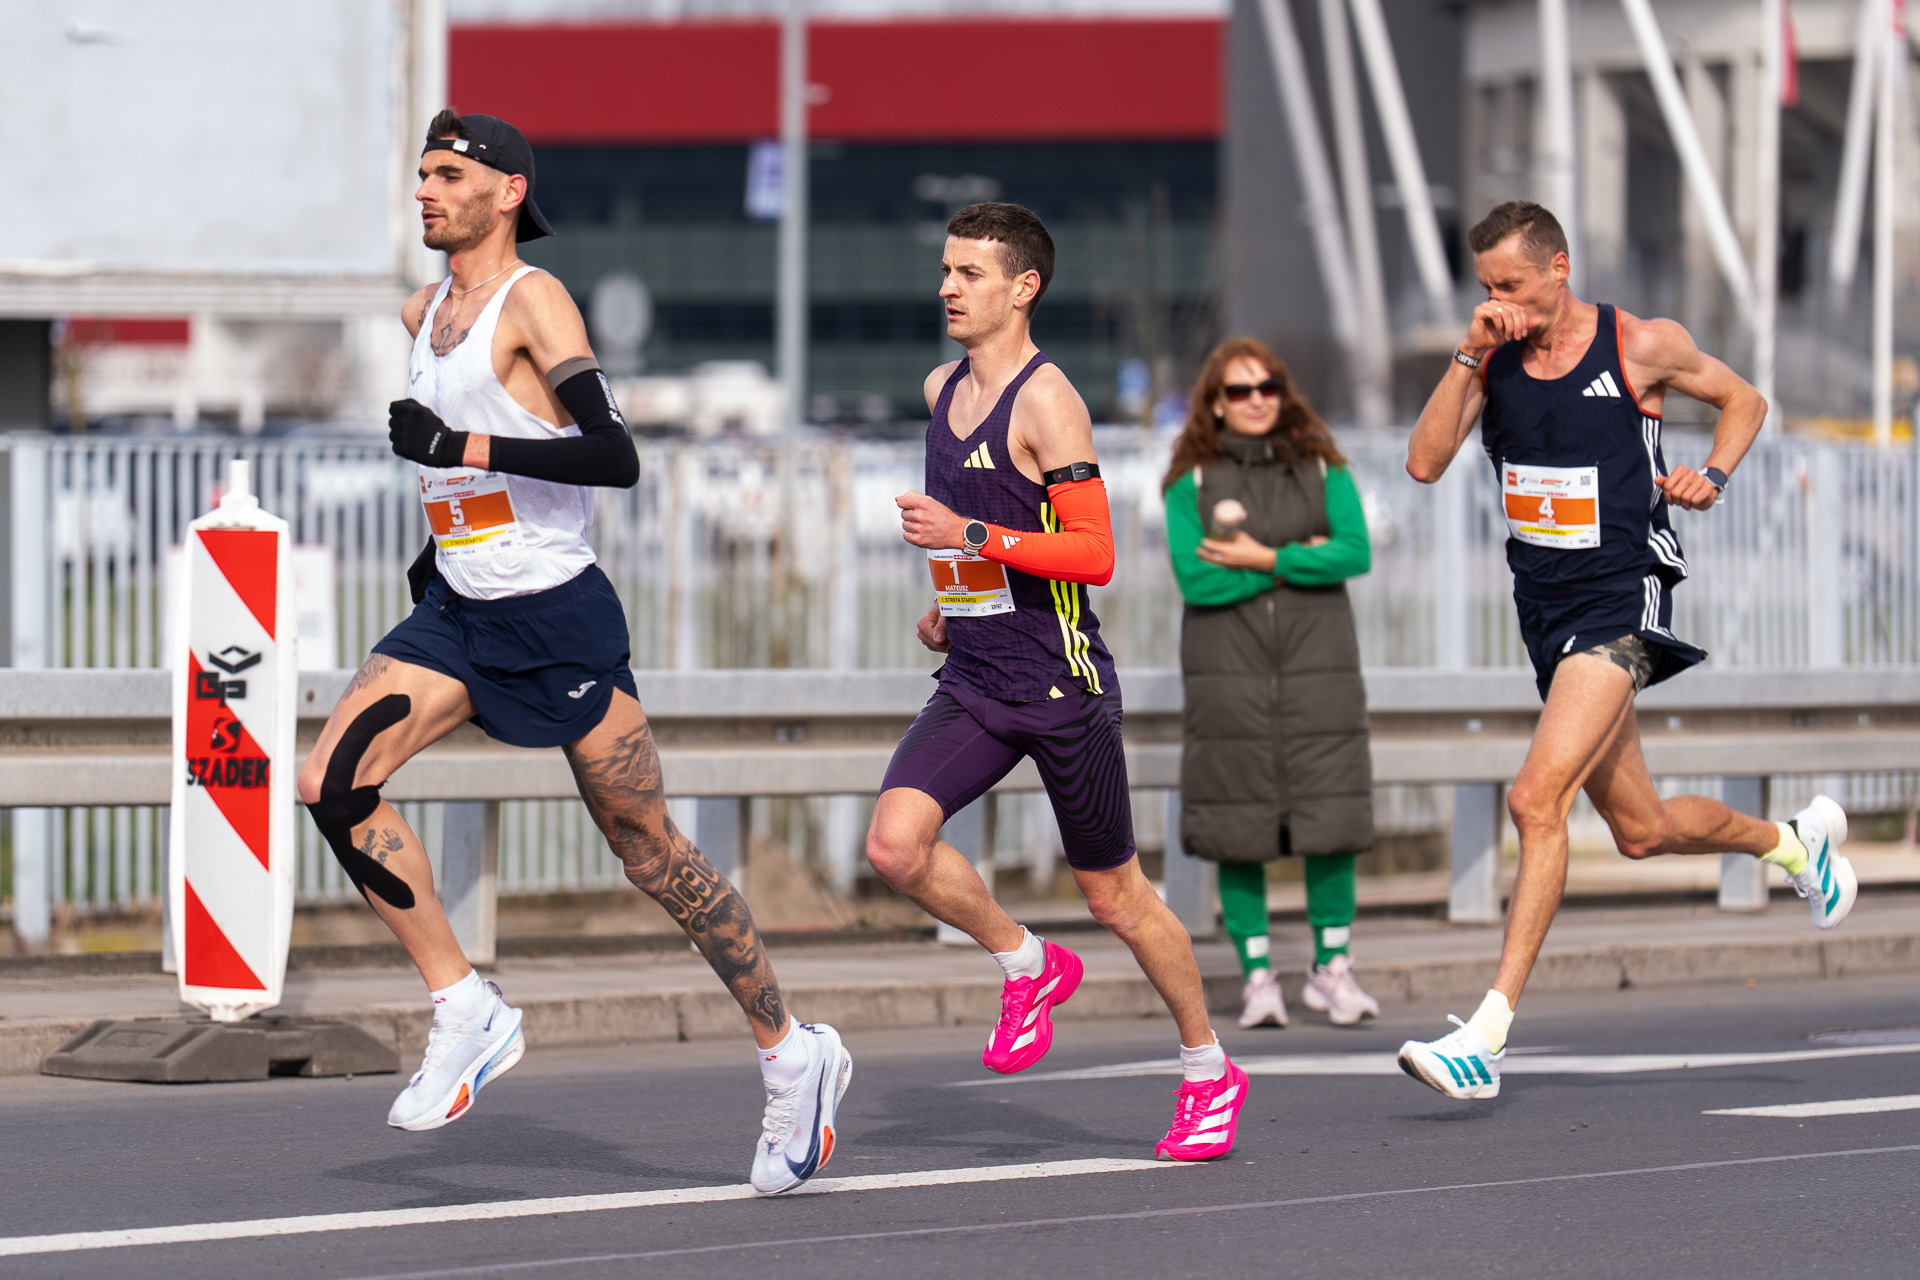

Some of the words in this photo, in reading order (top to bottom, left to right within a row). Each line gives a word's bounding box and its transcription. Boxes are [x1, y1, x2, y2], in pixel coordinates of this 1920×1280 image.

[448, 499, 465, 526] 5
[1538, 497, 1555, 519] 4
[949, 560, 960, 584] 1
[186, 757, 270, 787] SZADEK
